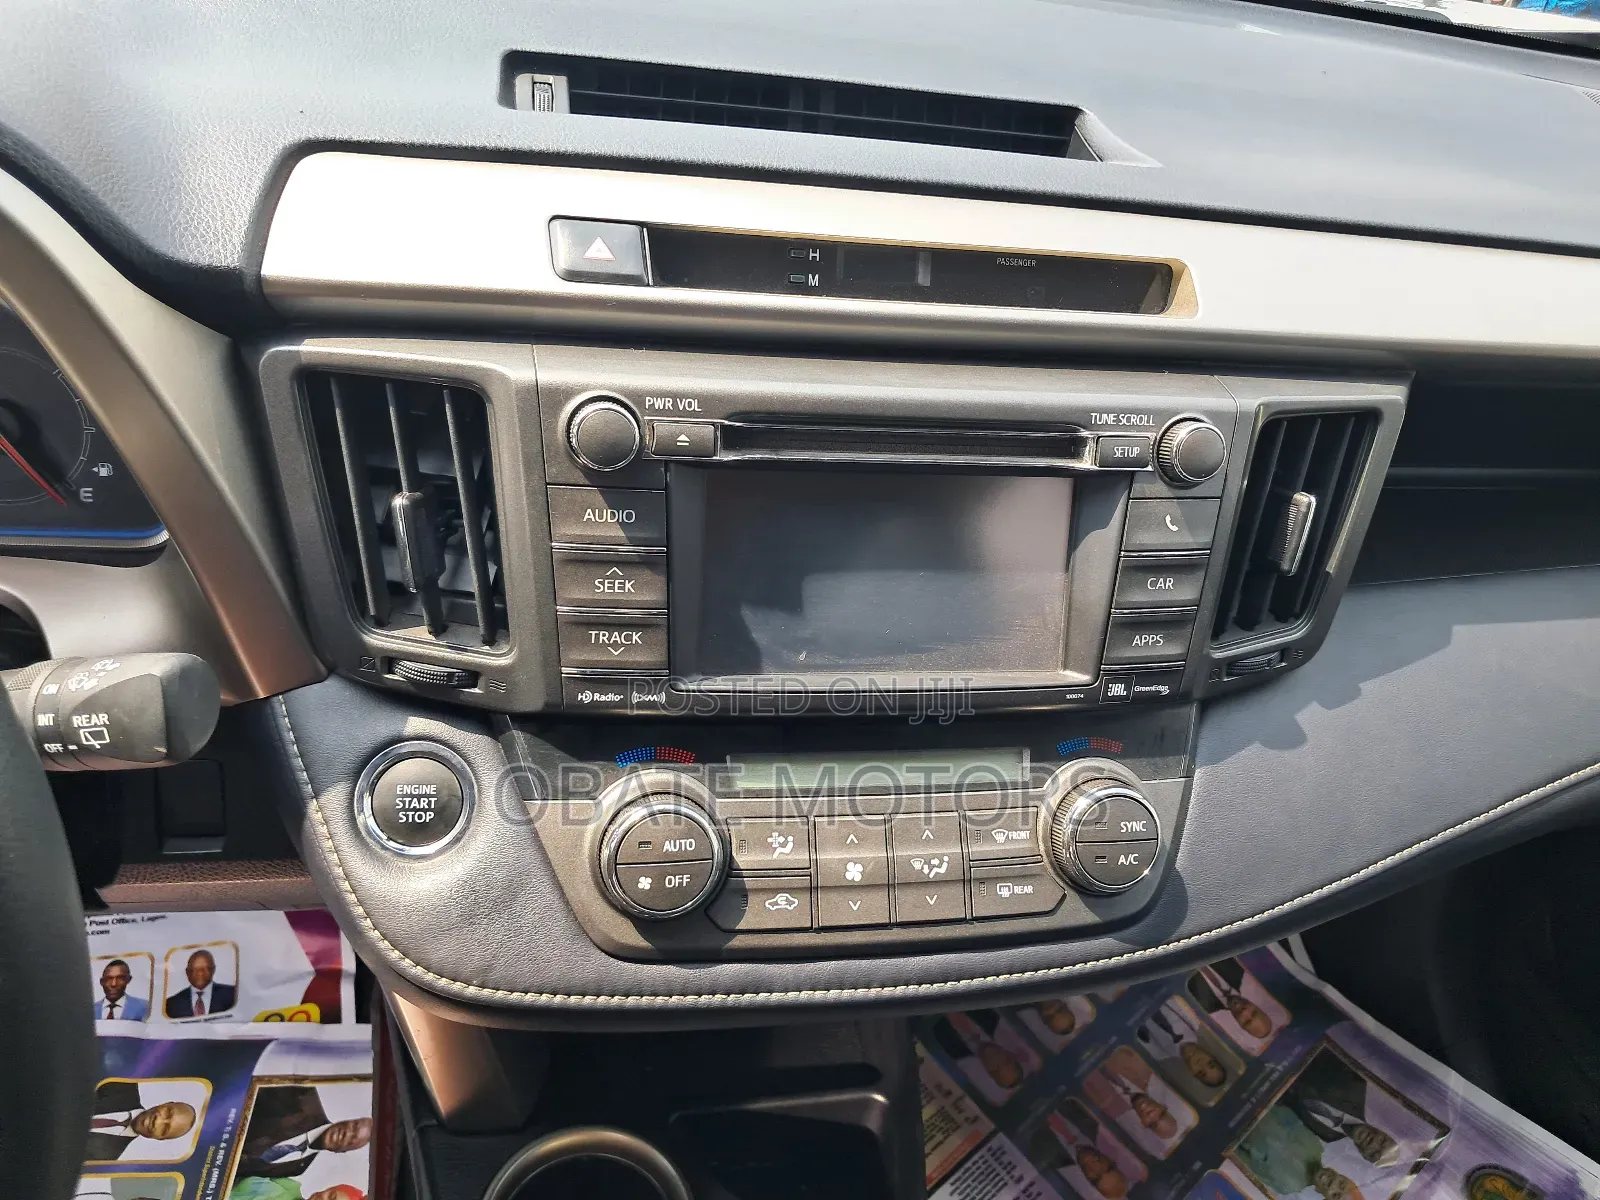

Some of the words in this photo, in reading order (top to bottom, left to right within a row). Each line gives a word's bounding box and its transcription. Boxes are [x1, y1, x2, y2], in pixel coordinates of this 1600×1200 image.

[809, 248, 820, 262] H
[996, 257, 1037, 268] PASSENGER
[808, 273, 820, 287] M
[645, 396, 673, 410] PWR
[676, 398, 703, 412] VOL
[1090, 412, 1118, 425] TUNE
[1118, 413, 1156, 426] SCROLL
[1113, 446, 1140, 458] SETUP
[79, 487, 94, 503] E
[583, 508, 636, 523] AUDIO
[594, 579, 635, 593] SEEK
[1147, 577, 1174, 590] CAR
[590, 631, 643, 645] TRACK
[1131, 634, 1164, 647] APPS
[1107, 683, 1127, 697] JBL
[37, 713, 55, 726] INT
[72, 713, 110, 728] REAR
[43, 743, 64, 753] OFF
[396, 784, 437, 795] ENGINE
[395, 797, 438, 809] START
[398, 811, 435, 823] STOP
[1120, 821, 1147, 833] SYNC
[1009, 830, 1031, 841] FRONT
[663, 838, 696, 853] AUTO
[1118, 853, 1139, 866] A/C
[665, 875, 691, 888] OFF
[1014, 885, 1034, 895] REAR
